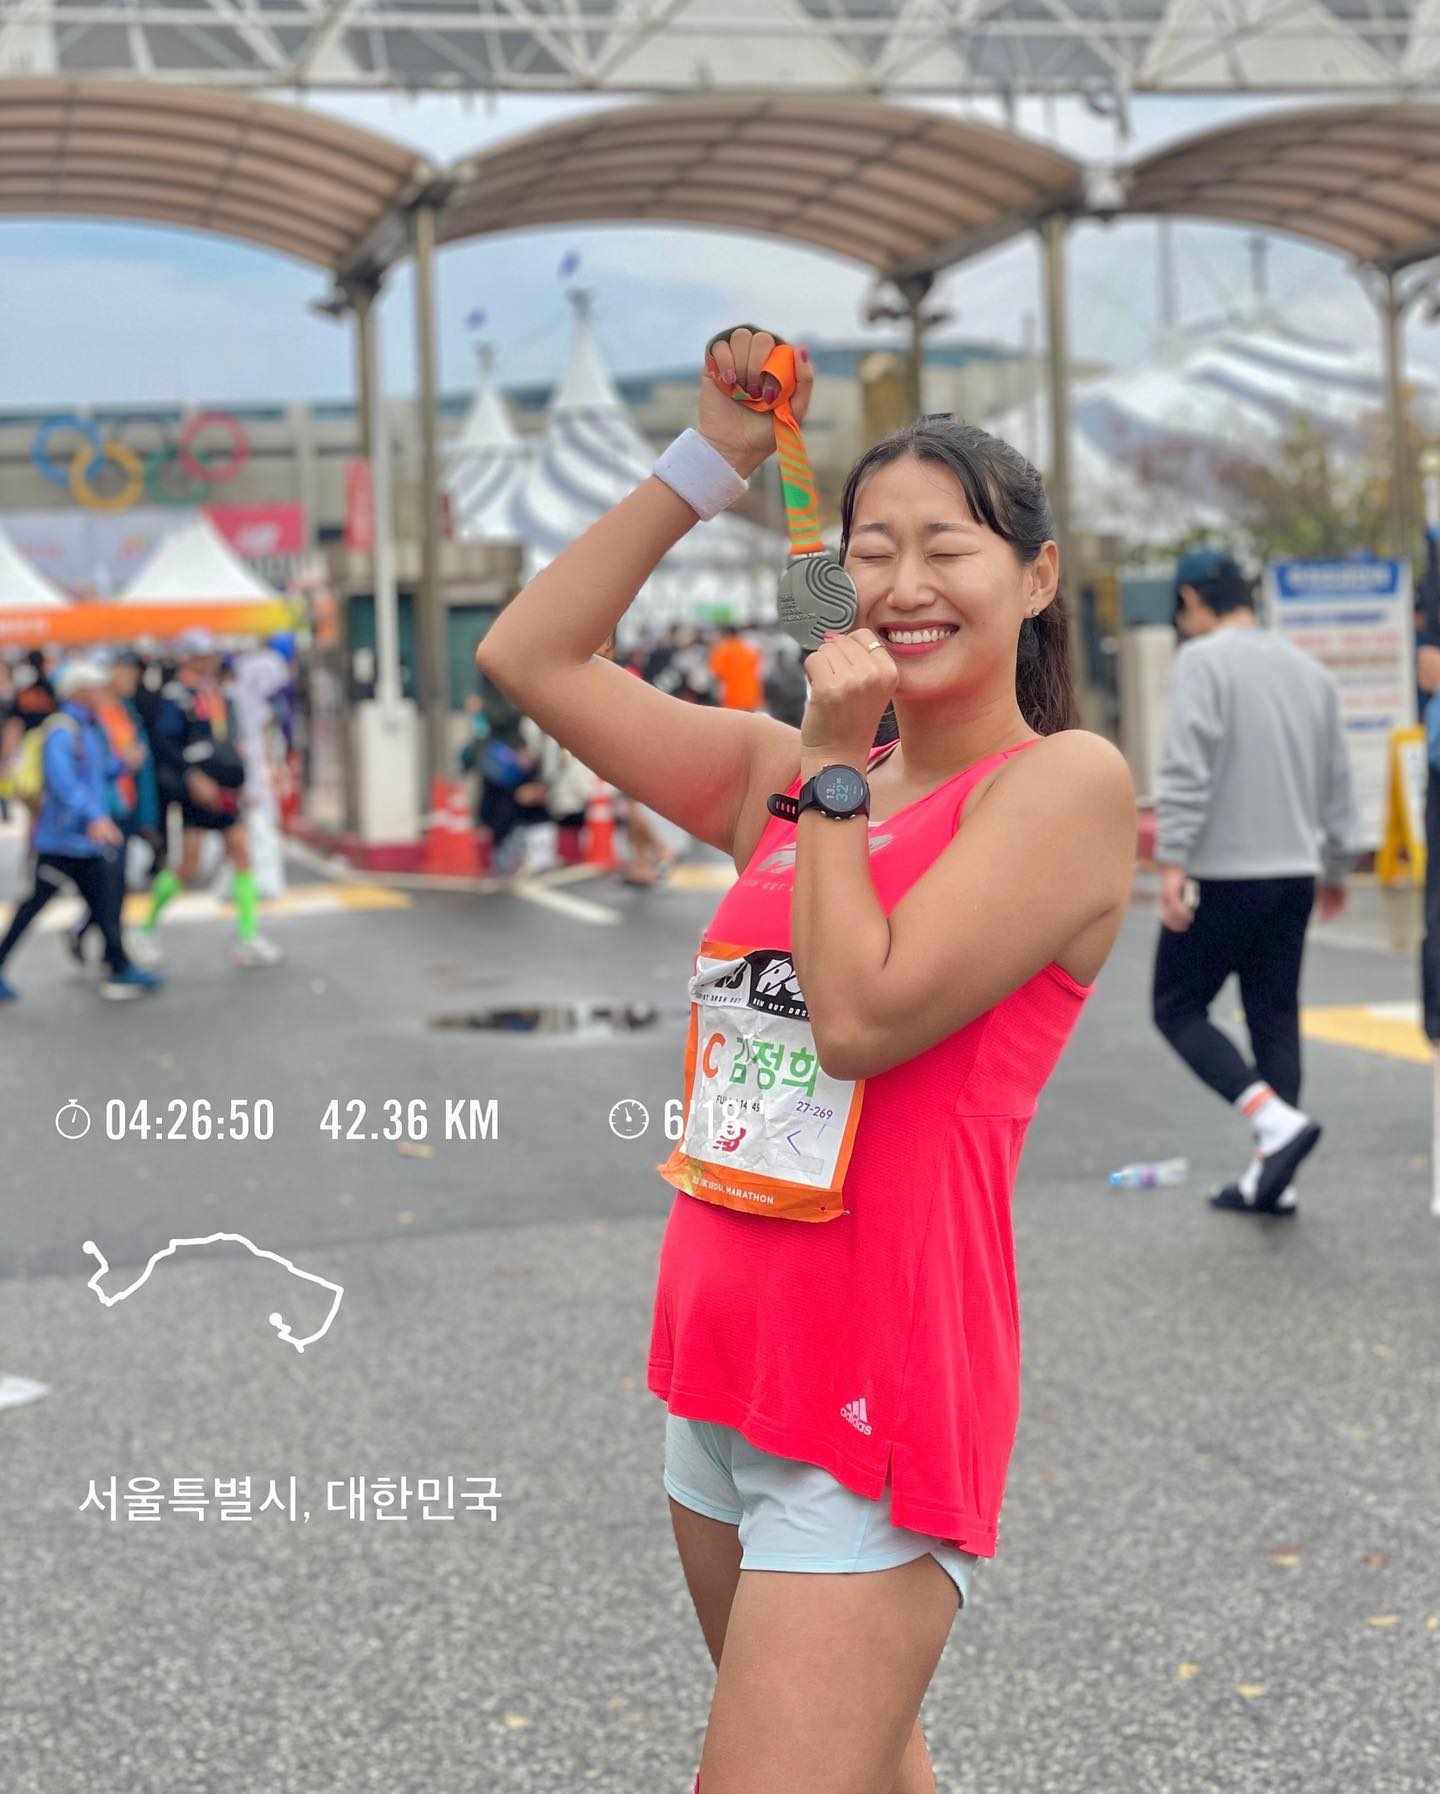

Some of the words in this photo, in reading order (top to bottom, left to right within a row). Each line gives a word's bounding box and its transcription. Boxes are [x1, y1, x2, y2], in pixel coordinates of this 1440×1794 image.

[836, 784, 848, 802] 32
[768, 1003, 785, 1012] OUT
[788, 1008, 810, 1019] DAS
[702, 1032, 727, 1079] C
[728, 1036, 822, 1098] 김정희
[796, 1101, 834, 1121] 27-269
[726, 1186, 774, 1205] MARATHON
[840, 1407, 873, 1436] adidas
